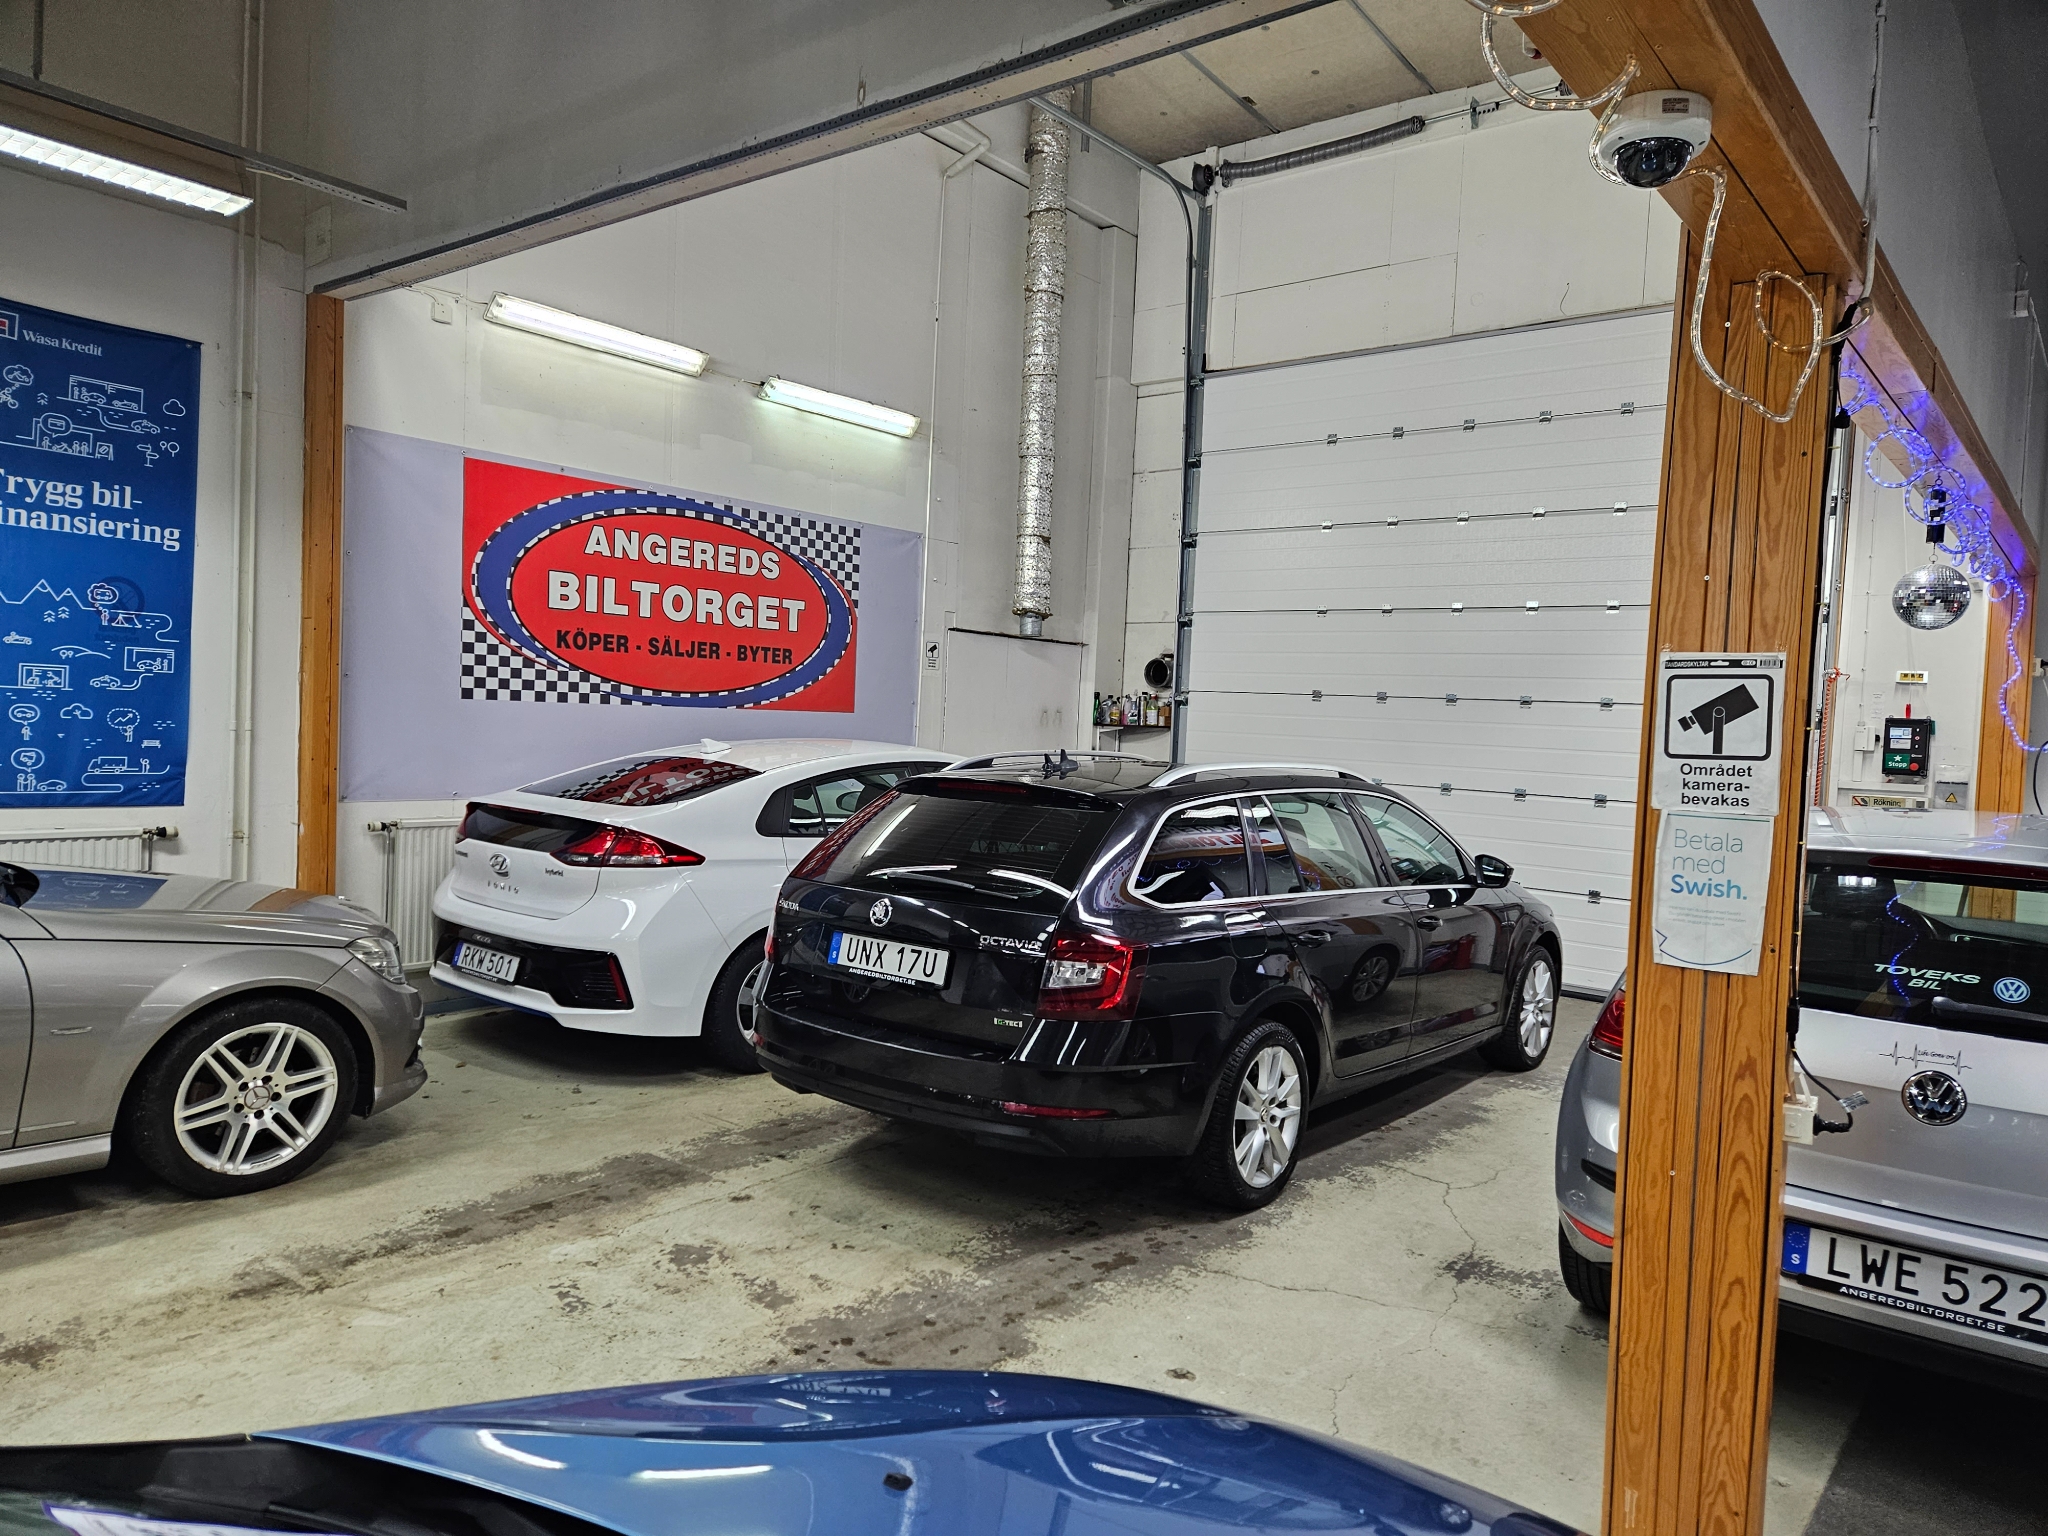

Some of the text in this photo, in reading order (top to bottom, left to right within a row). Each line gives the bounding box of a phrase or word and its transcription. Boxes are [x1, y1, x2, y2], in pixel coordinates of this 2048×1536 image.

[23, 329, 103, 357] Wasa Kredit
[0, 469, 143, 510] rygg bil-
[0, 505, 182, 551] nansiering
[584, 524, 780, 581] ANGEREDS
[547, 570, 806, 633] BILTORGET
[556, 627, 630, 654] KÖPER
[648, 633, 721, 661] SÄLJER
[737, 643, 793, 665] BYTER
[1680, 763, 1753, 778] Området
[1682, 777, 1750, 792] kamera-
[1681, 792, 1750, 807] bevakas
[1674, 828, 1743, 853] Betala
[1672, 855, 1726, 875] med
[1670, 873, 1748, 900] Swish.
[979, 935, 1039, 950] OCTAVIA
[461, 946, 487, 970] RKW
[486, 952, 513, 978] 501
[846, 937, 888, 969] UNX
[896, 946, 939, 978] 17U
[1874, 963, 1981, 985] TOVEKS
[1907, 978, 1942, 990] BIL
[1790, 1236, 2047, 1327] S LWE 522
[1839, 1285, 2006, 1333] ANGEREDBILTORGET.SE
